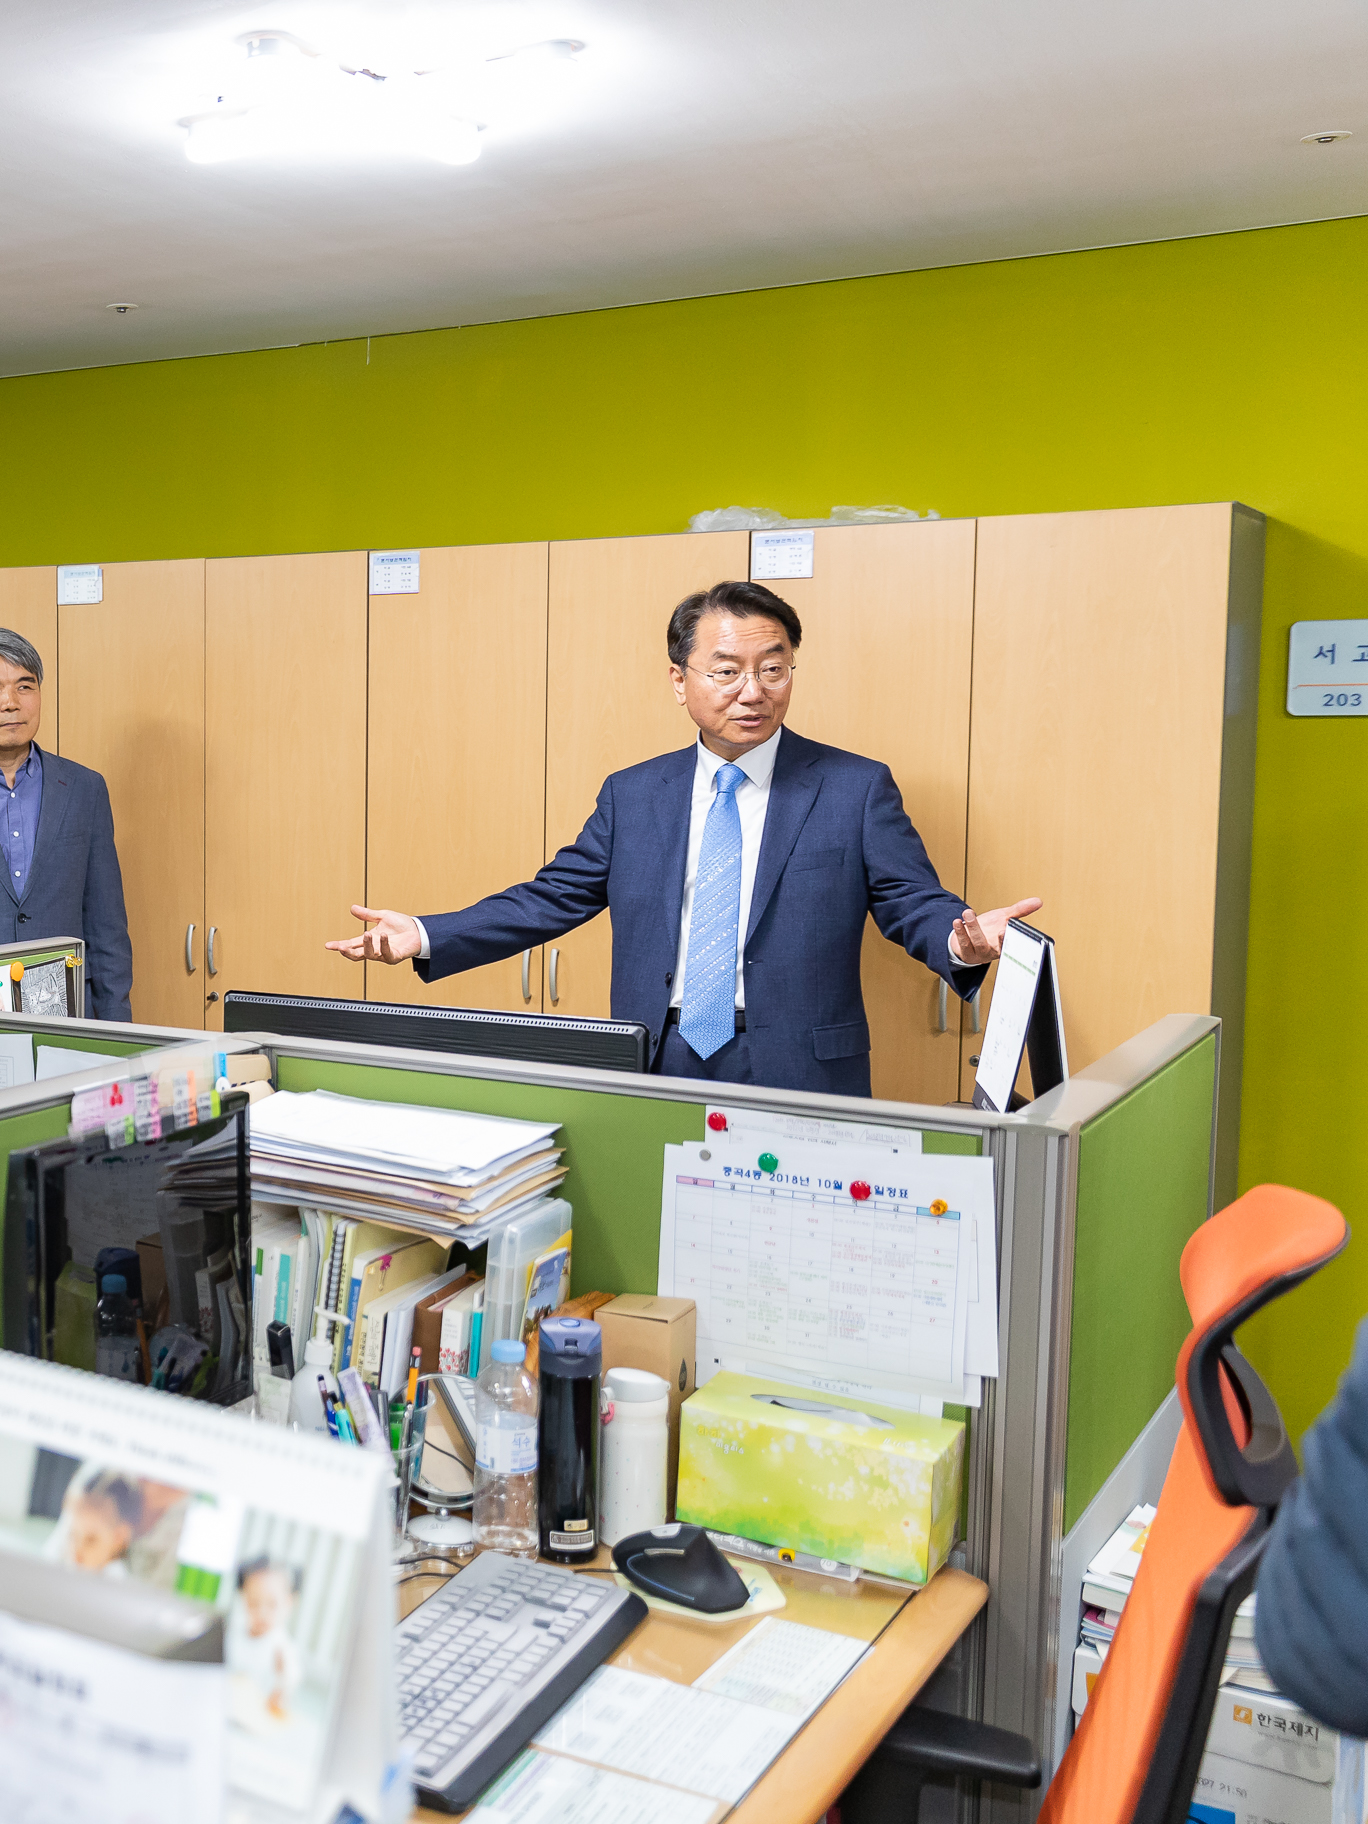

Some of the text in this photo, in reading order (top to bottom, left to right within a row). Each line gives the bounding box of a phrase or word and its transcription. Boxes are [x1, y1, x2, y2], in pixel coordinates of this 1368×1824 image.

[1322, 693, 1362, 707] 203
[769, 1171, 810, 1187] 2018년
[817, 1178, 843, 1191] 10월
[870, 1184, 909, 1199] 일정표
[511, 1436, 531, 1449] 석수
[1256, 1712, 1319, 1742] 한국제지
